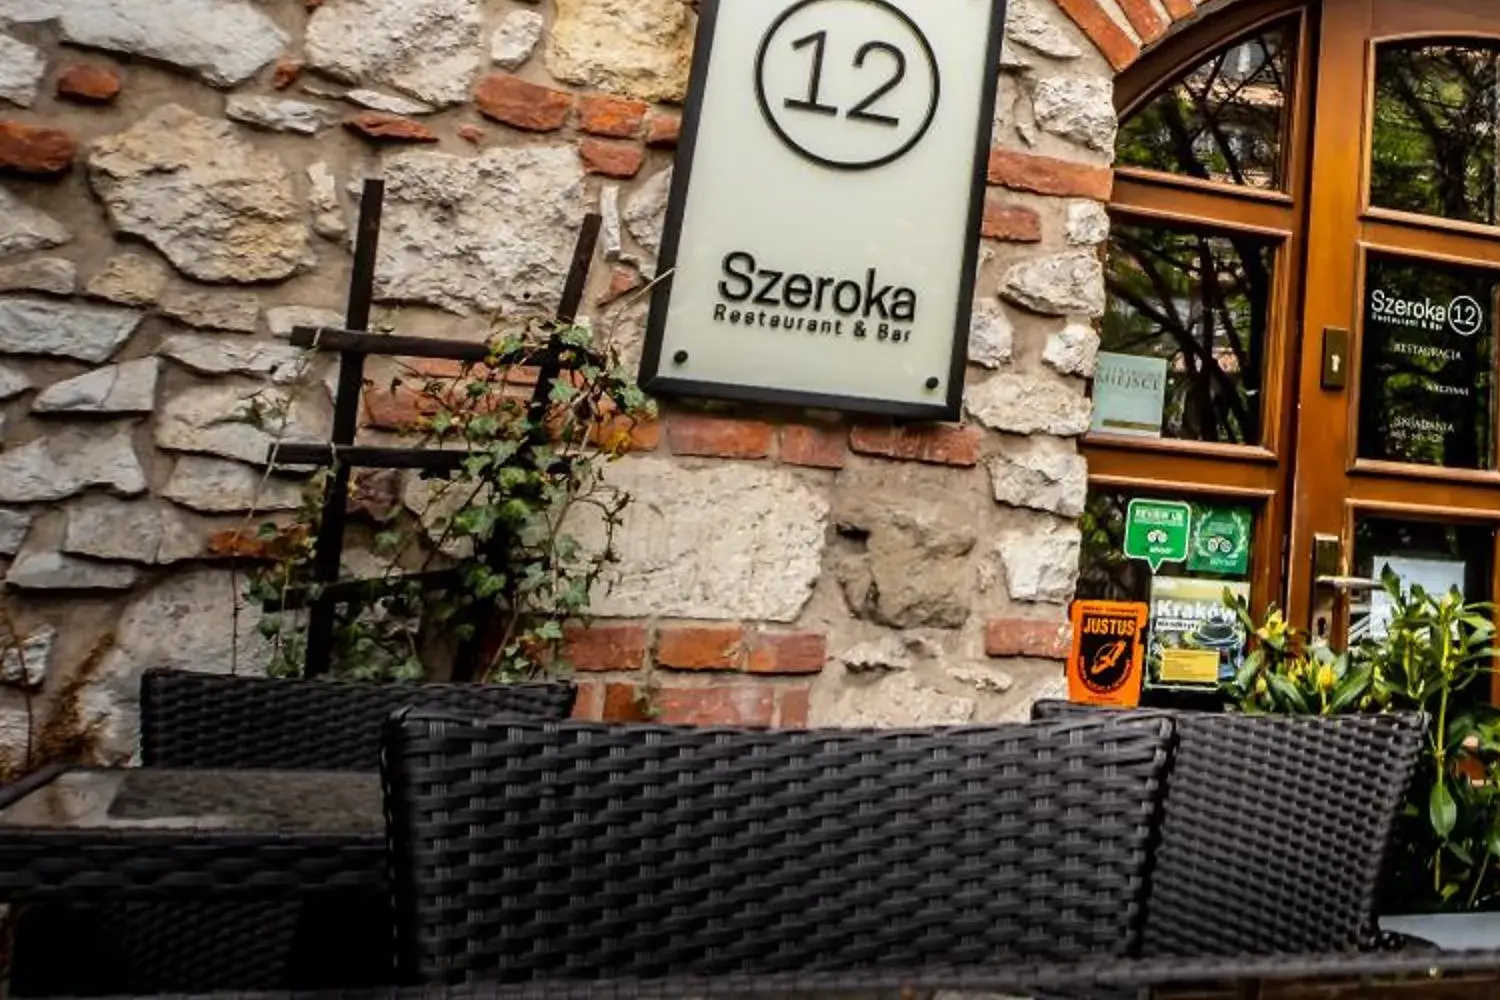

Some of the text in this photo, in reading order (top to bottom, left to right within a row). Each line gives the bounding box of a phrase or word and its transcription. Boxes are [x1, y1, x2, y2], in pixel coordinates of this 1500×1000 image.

[783, 29, 907, 127] 12
[718, 251, 917, 323] Szeroka
[713, 303, 912, 343] Restaurant & Bar
[1371, 289, 1477, 327] Szeroka 12
[1083, 617, 1136, 636] JUSTUS
